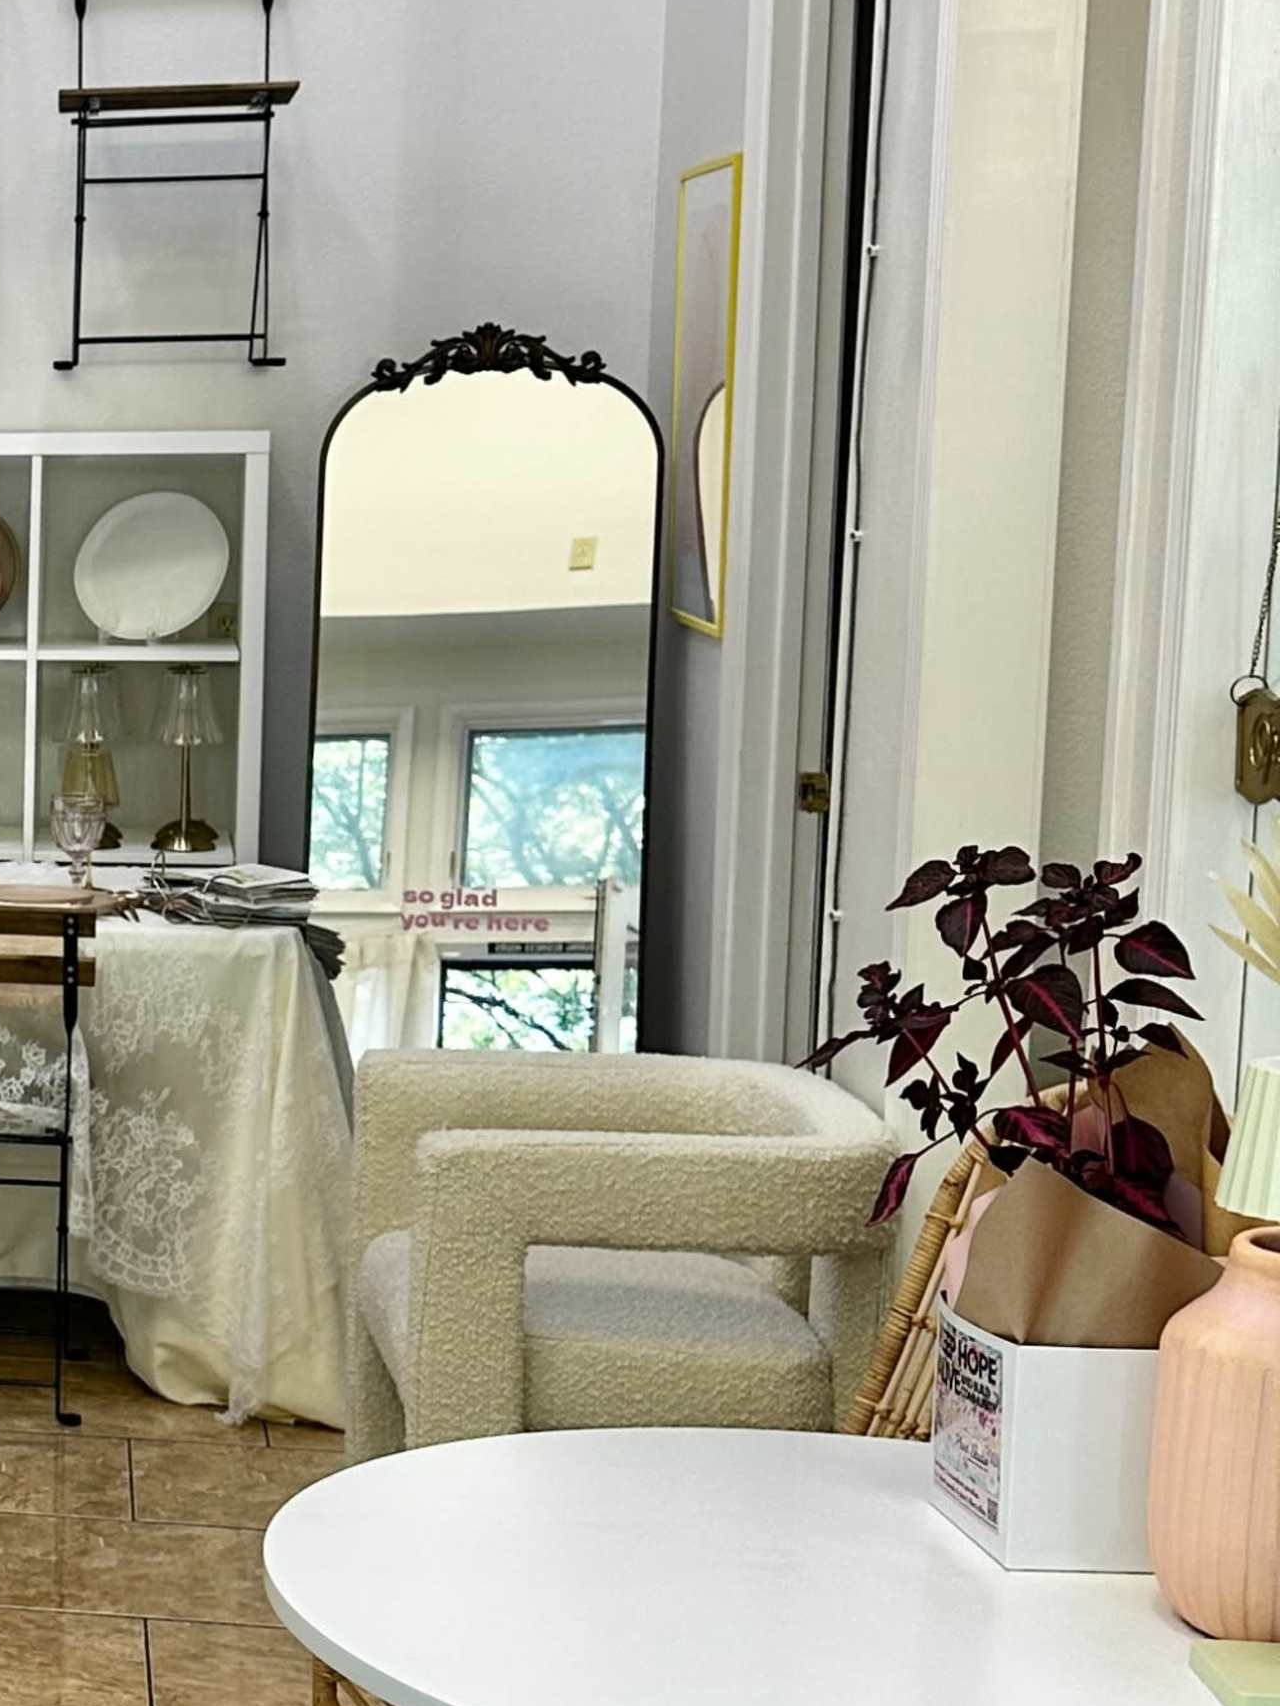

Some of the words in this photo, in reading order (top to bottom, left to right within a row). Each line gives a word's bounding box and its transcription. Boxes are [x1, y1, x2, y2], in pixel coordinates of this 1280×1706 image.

[403, 890, 434, 904] so
[440, 888, 498, 910] glad
[401, 911, 480, 931] you're
[487, 912, 550, 931] here
[958, 1339, 997, 1386] HOPE
